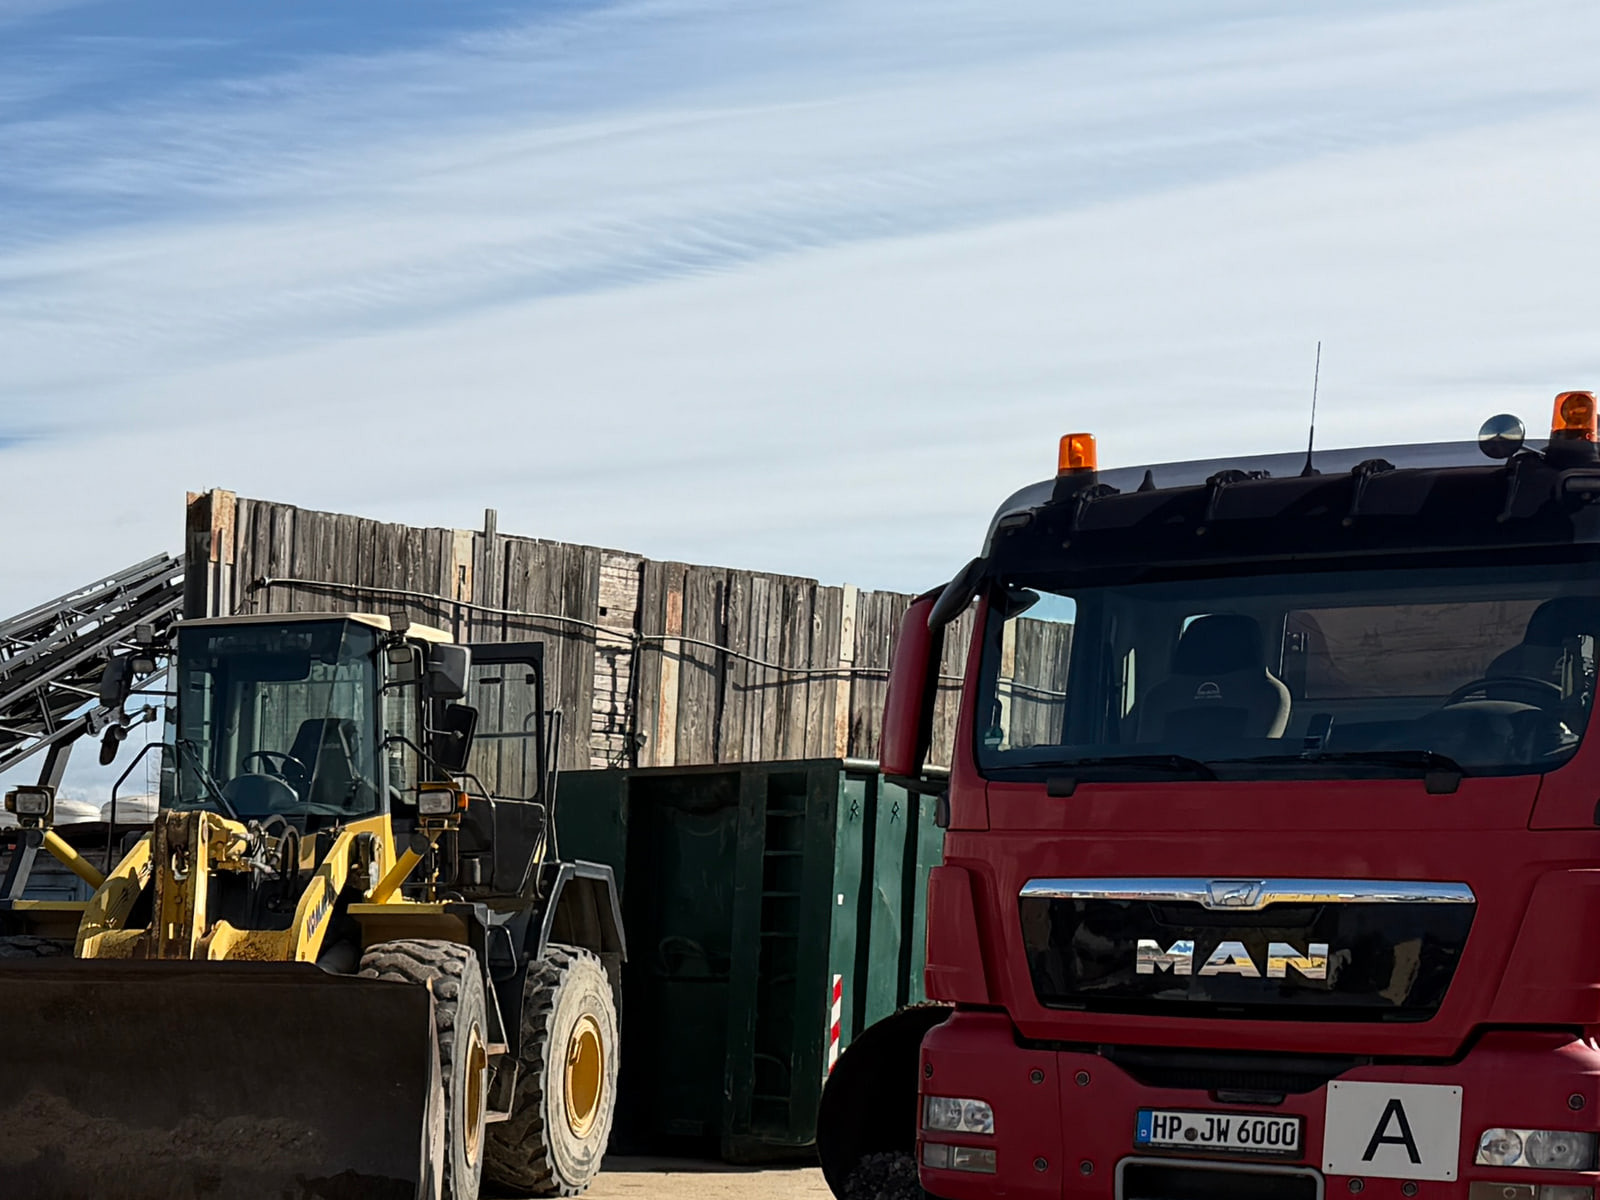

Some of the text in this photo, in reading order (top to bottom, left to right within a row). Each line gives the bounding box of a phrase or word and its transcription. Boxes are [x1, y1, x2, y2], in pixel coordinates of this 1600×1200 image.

[1136, 938, 1330, 980] MAN
[1151, 1114, 1183, 1140] HP
[1200, 1117, 1231, 1143] JW
[1237, 1119, 1296, 1147] 6000
[1361, 1098, 1422, 1165] A
